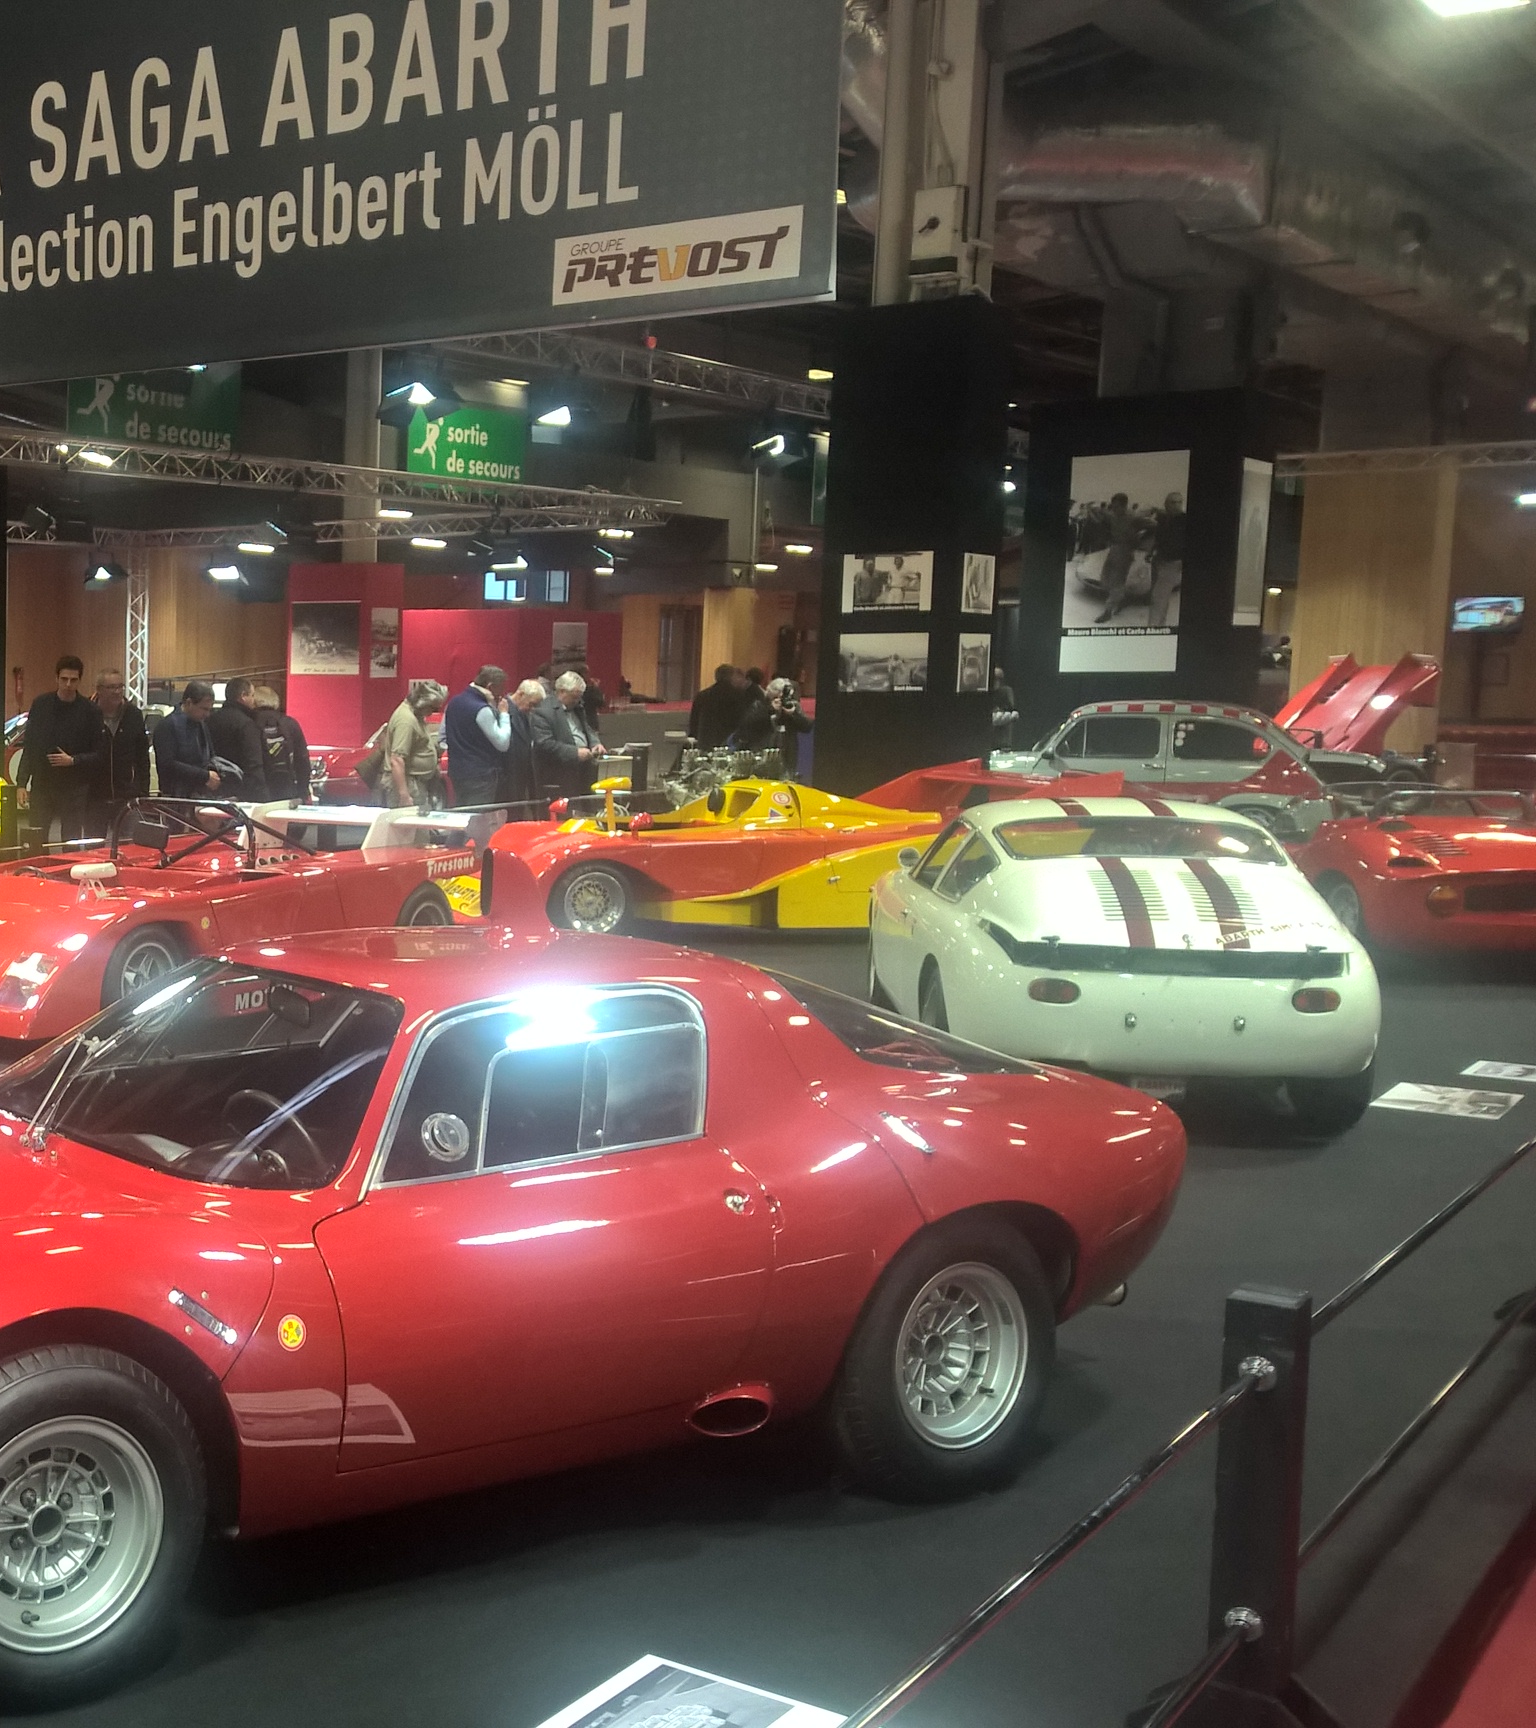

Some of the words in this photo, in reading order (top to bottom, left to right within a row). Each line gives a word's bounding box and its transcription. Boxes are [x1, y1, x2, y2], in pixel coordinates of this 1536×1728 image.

[29, 46, 230, 188] SAGA
[260, 0, 648, 147] ABARTH
[173, 151, 442, 279] Engelbert
[463, 104, 639, 226] MÖLL
[570, 238, 626, 258] GROUPE
[125, 411, 152, 440] de
[157, 425, 232, 451] secours
[447, 423, 488, 447] sortie
[446, 450, 465, 473] de
[468, 459, 521, 480] secours
[427, 856, 476, 878] Firestone
[1215, 928, 1265, 945] ABARTH
